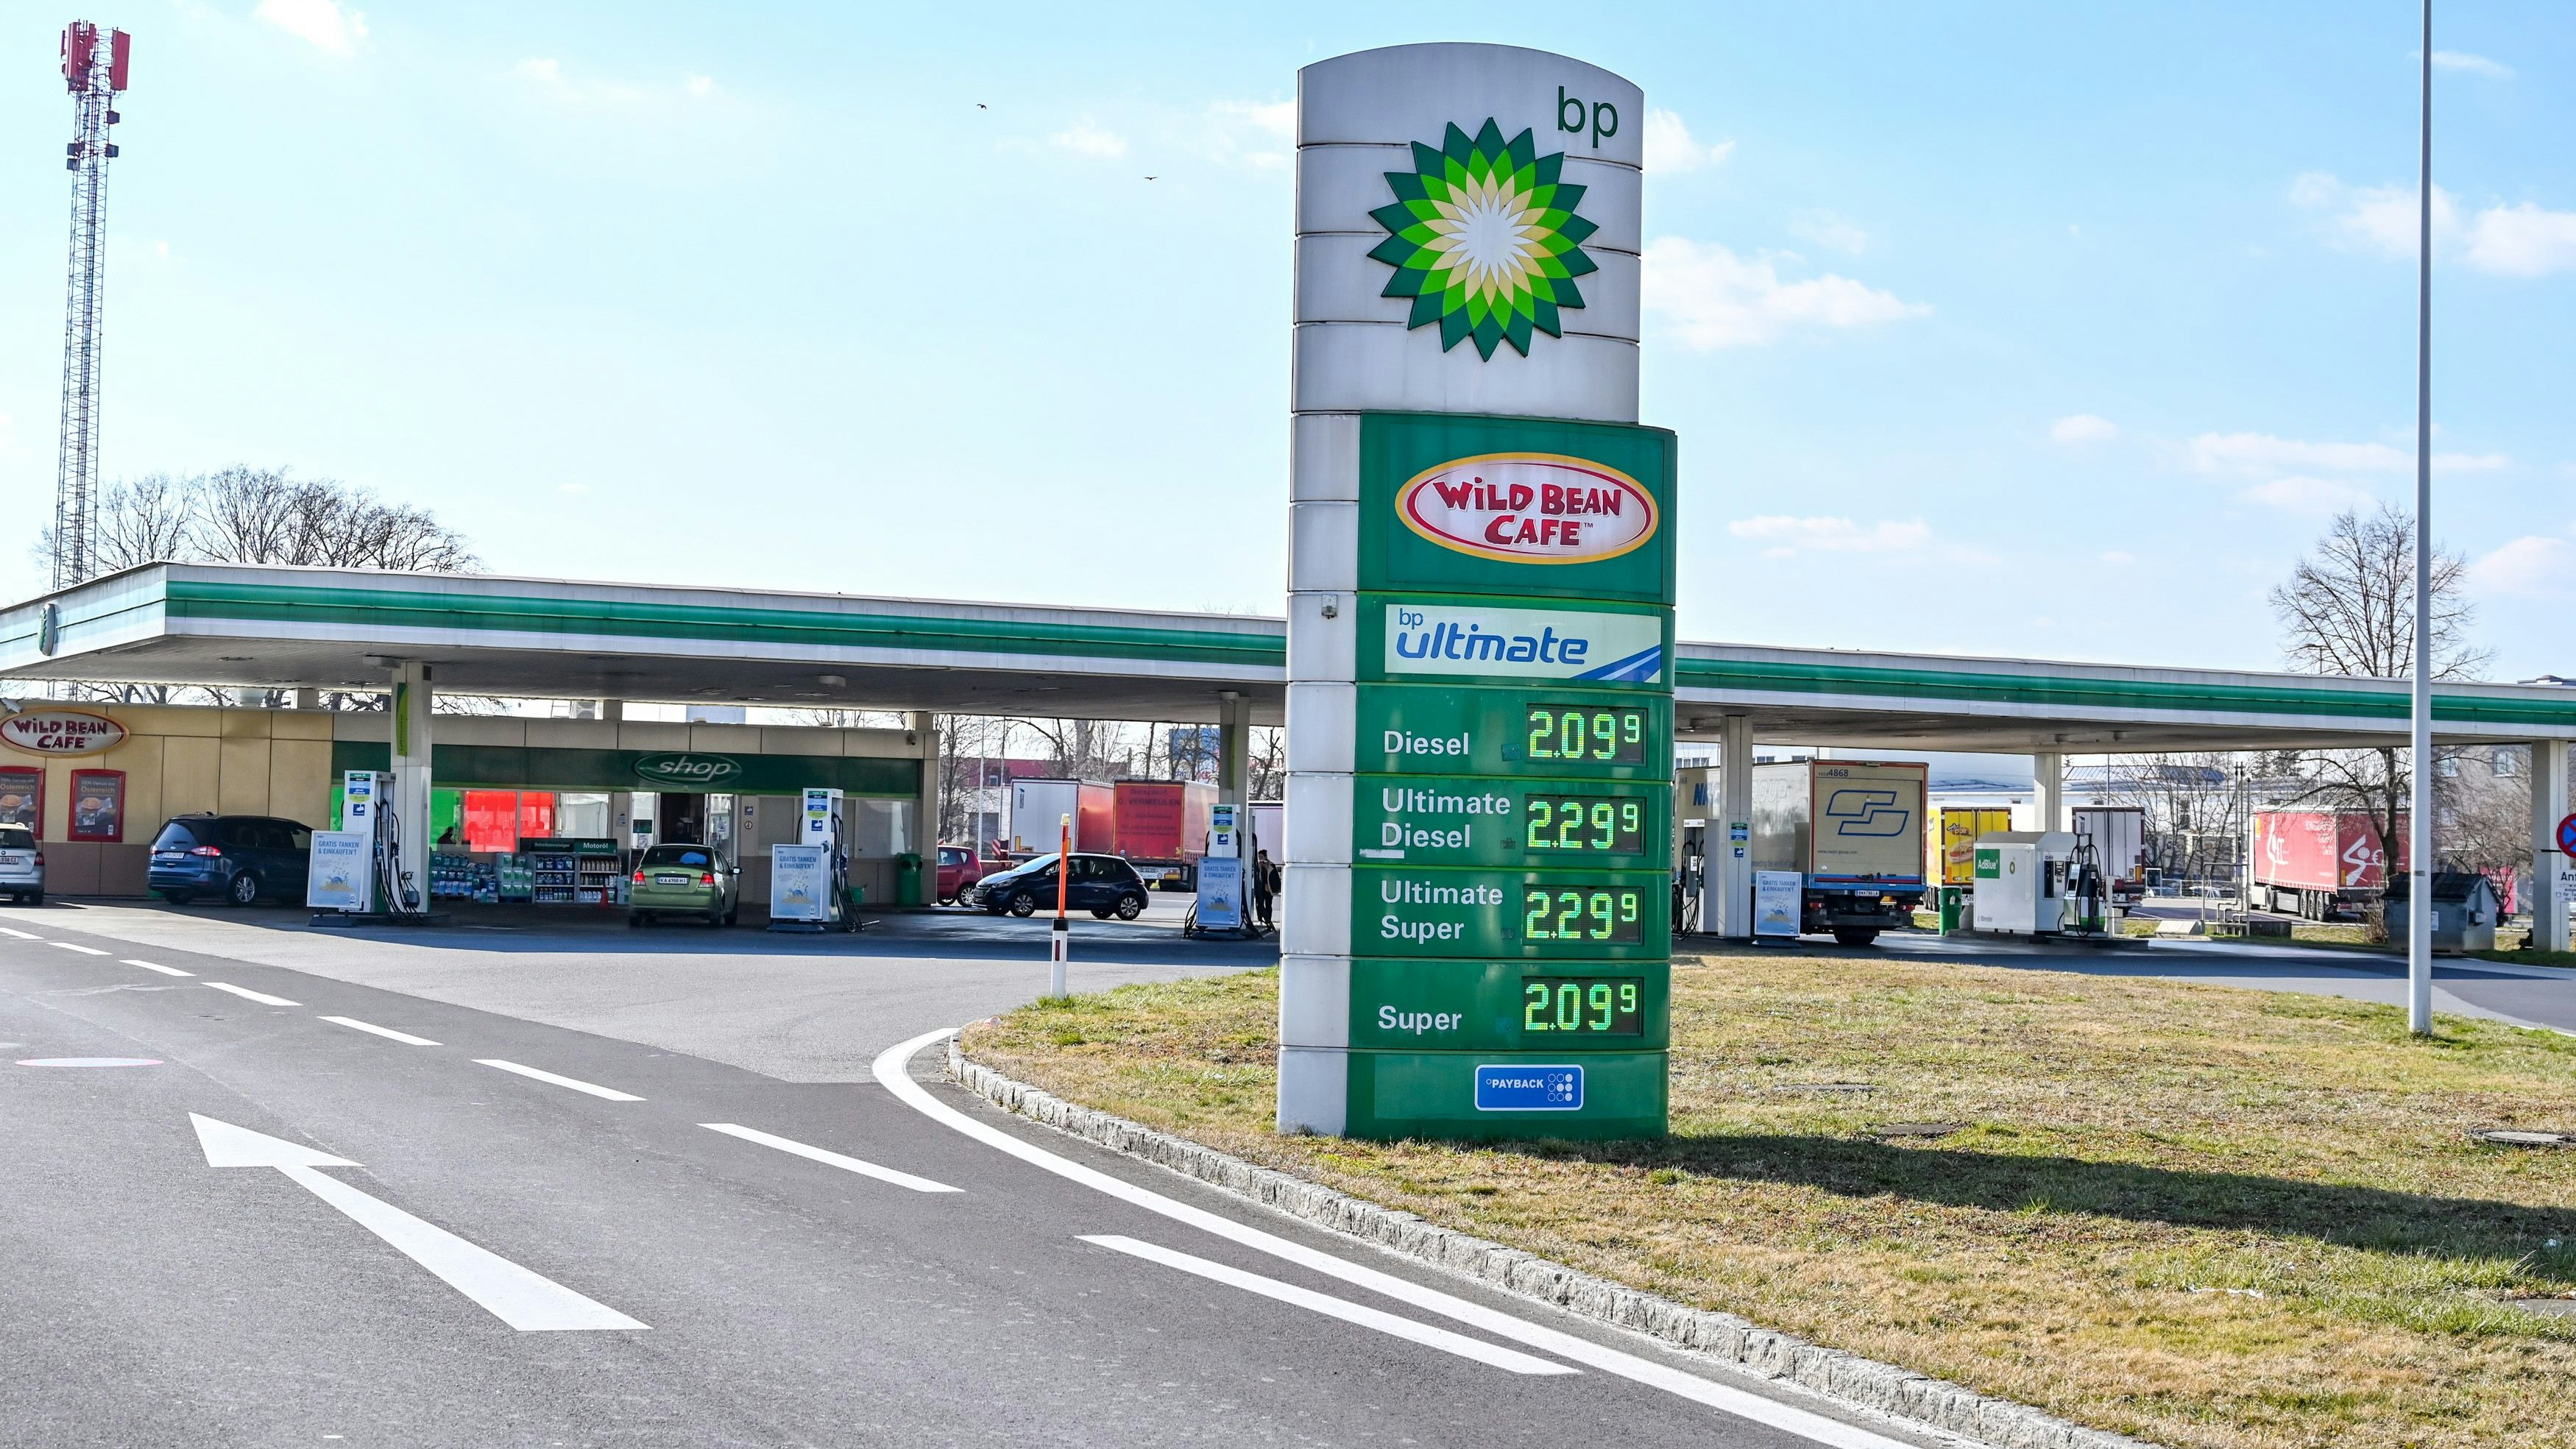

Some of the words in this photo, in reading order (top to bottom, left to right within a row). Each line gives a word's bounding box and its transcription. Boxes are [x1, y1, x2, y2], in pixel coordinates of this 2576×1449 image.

[1557, 85, 1618, 149] bp
[1540, 482, 1622, 517] BEAN
[1484, 514, 1582, 547] CAFE
[1399, 608, 1424, 631] bp
[1396, 622, 1589, 665] ultimate
[65, 720, 107, 735] BEAN
[37, 734, 86, 749] CAFE
[1384, 730, 1469, 757] Diesel
[659, 755, 731, 782] shop
[1828, 768, 1849, 777] 4868
[80, 785, 116, 793] Österreich
[1382, 788, 1511, 815] Ultimate
[1381, 822, 1471, 849] Diesel
[2561, 871, 2576, 882] An
[1381, 880, 1503, 905] Ultimate
[1380, 915, 1465, 944] Super
[1378, 1005, 1462, 1035] Super
[1492, 1079, 1544, 1088] PAYBACK
